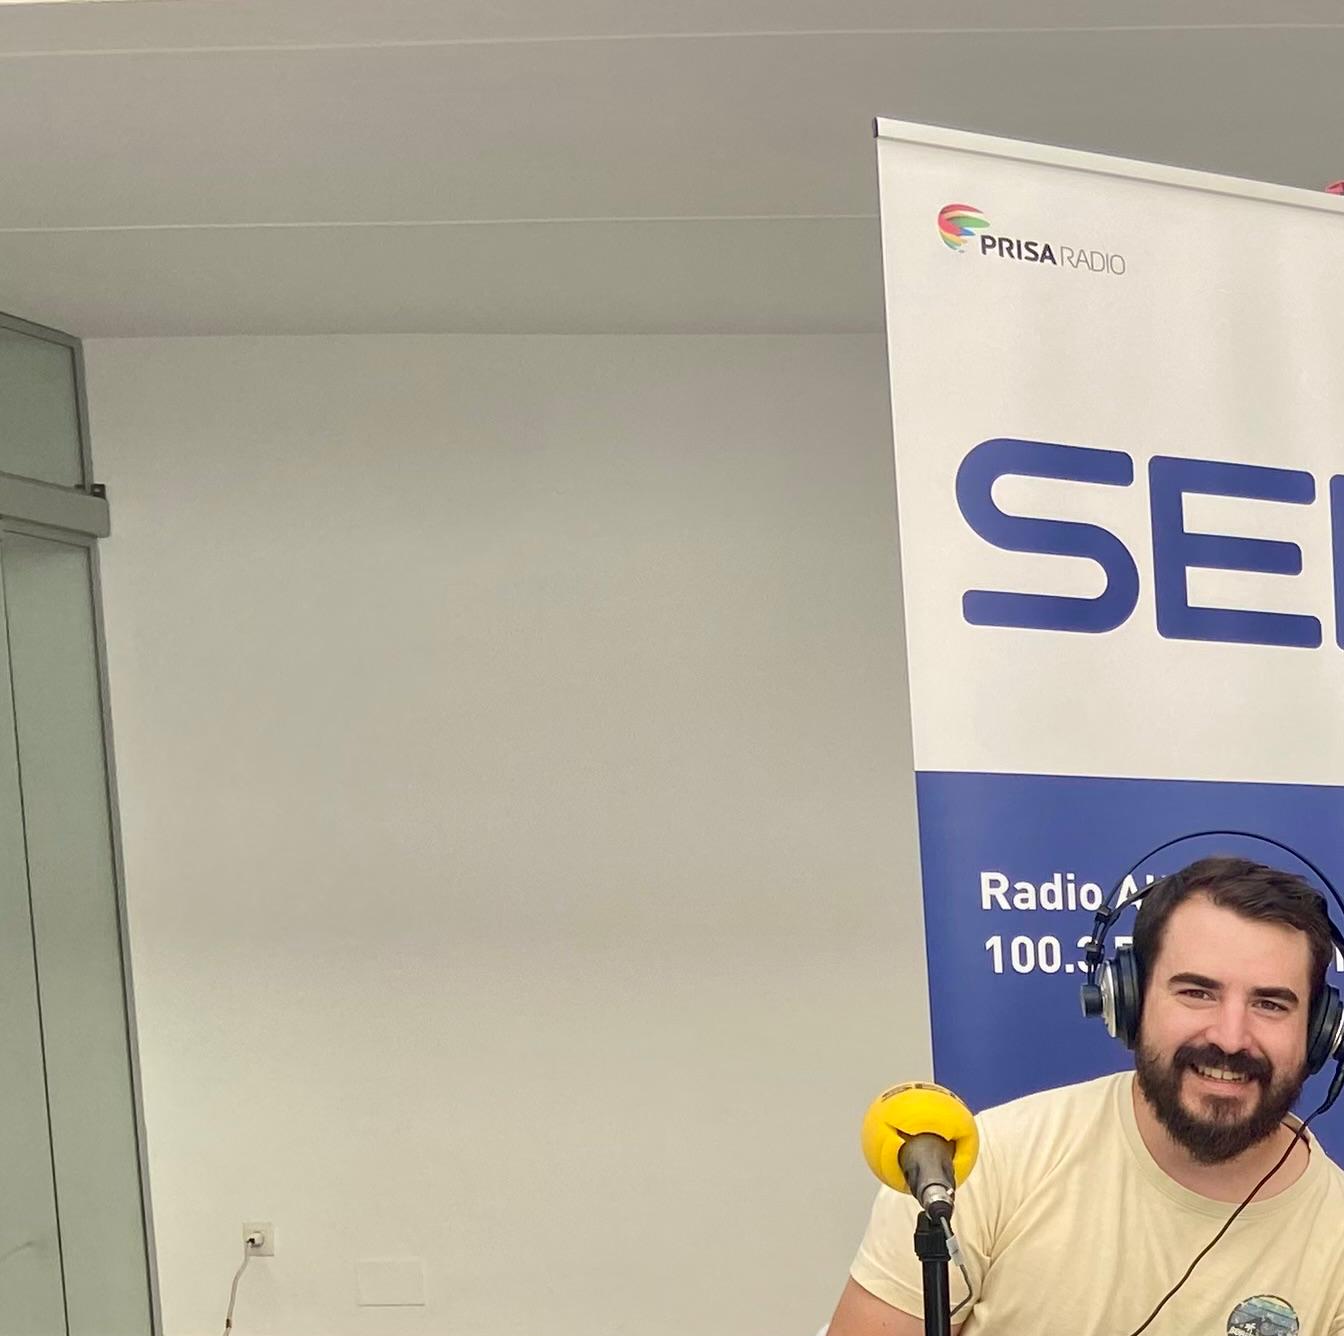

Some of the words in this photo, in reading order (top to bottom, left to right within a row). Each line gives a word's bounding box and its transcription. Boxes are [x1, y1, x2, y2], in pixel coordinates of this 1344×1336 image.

[980, 234, 1058, 266] PRISA
[1060, 246, 1126, 276] RADIO
[979, 871, 1101, 911] Radio
